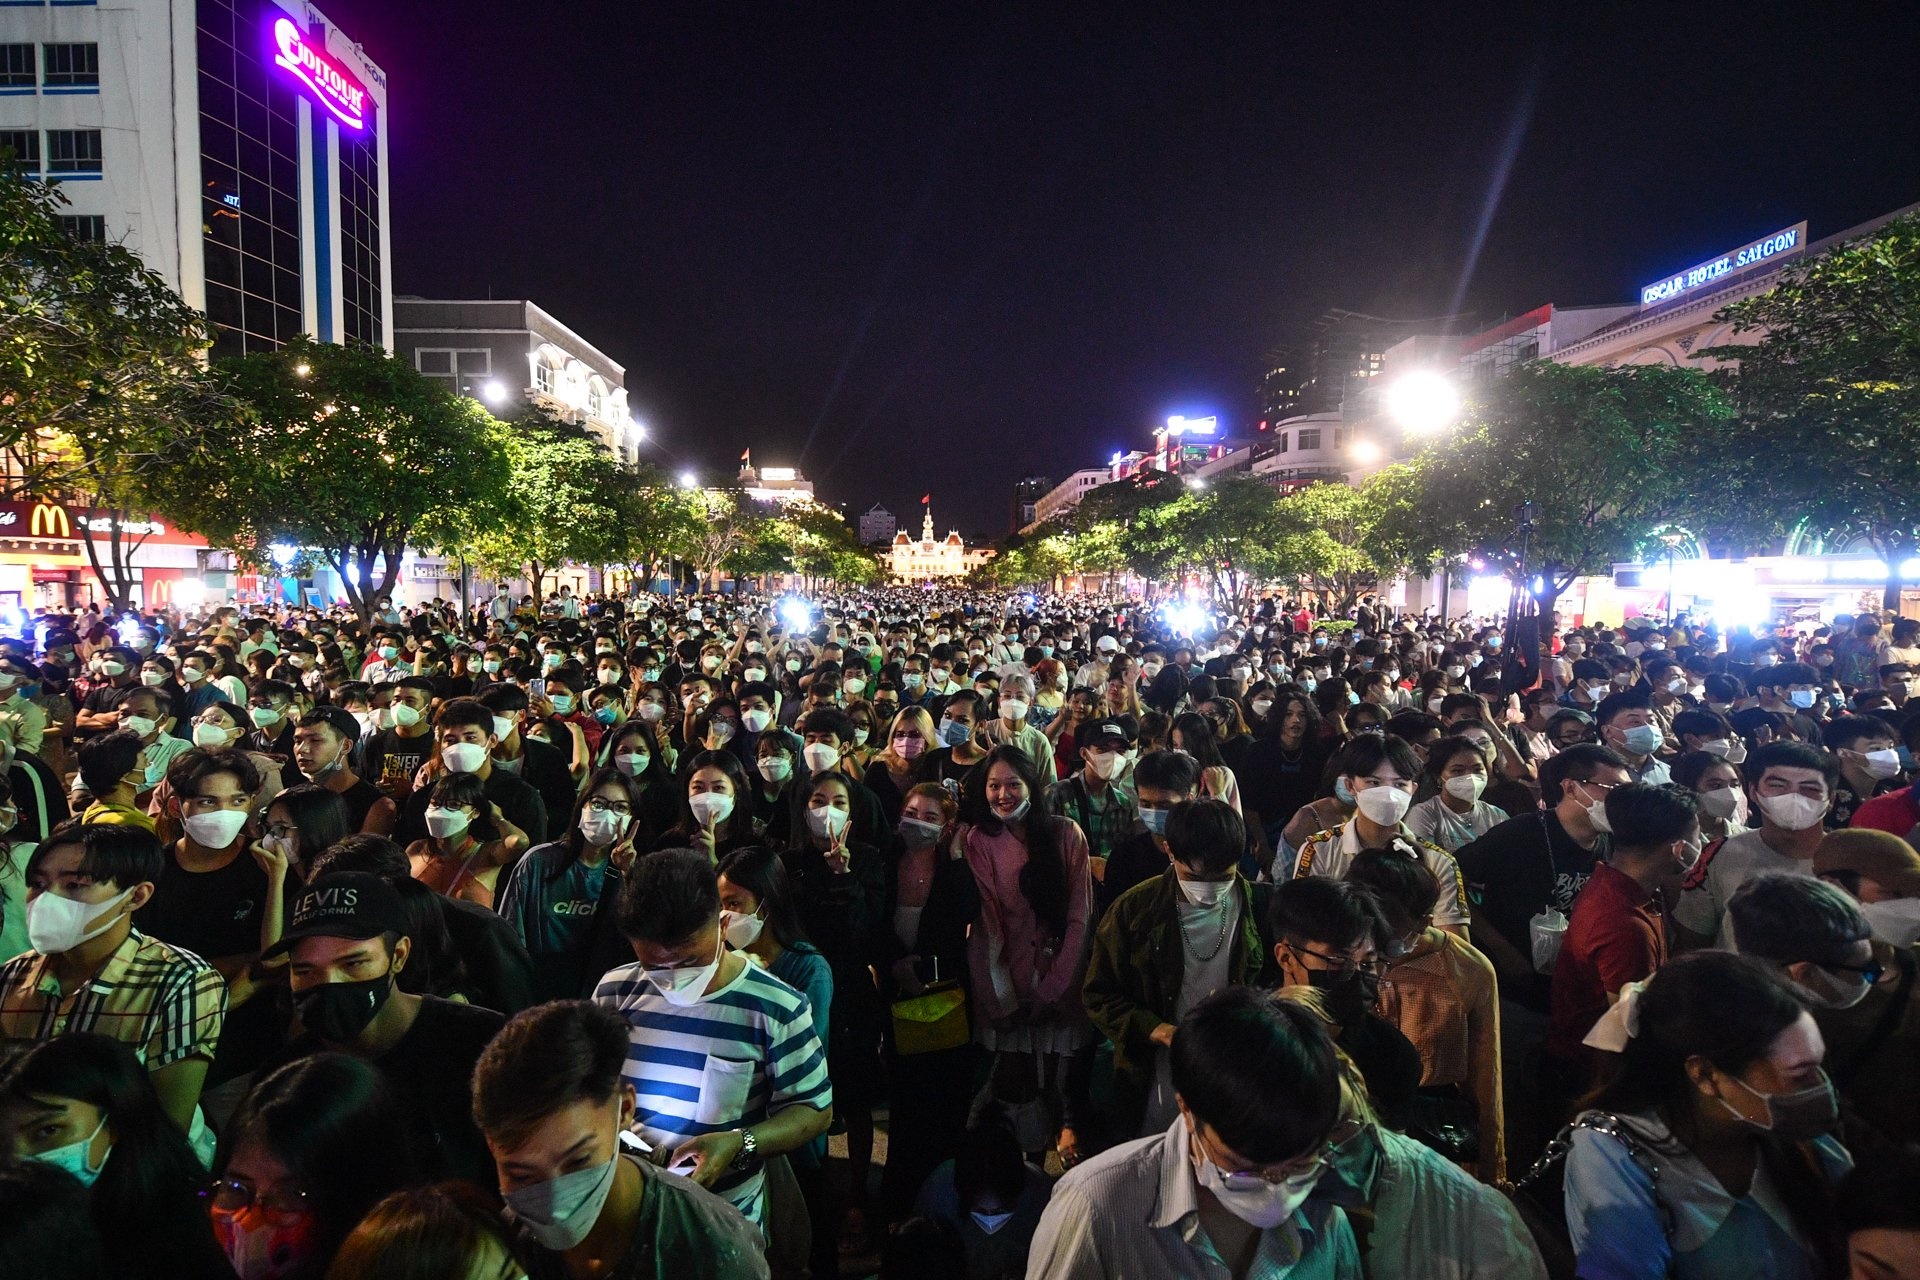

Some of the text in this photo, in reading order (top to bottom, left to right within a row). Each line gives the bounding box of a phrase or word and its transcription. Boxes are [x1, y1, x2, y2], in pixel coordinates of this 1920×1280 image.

[1643, 230, 1797, 304] OSCAR HOTEL SAIGON
[294, 888, 358, 916] LEVI'S
[292, 907, 356, 926] CALIFORNIA
